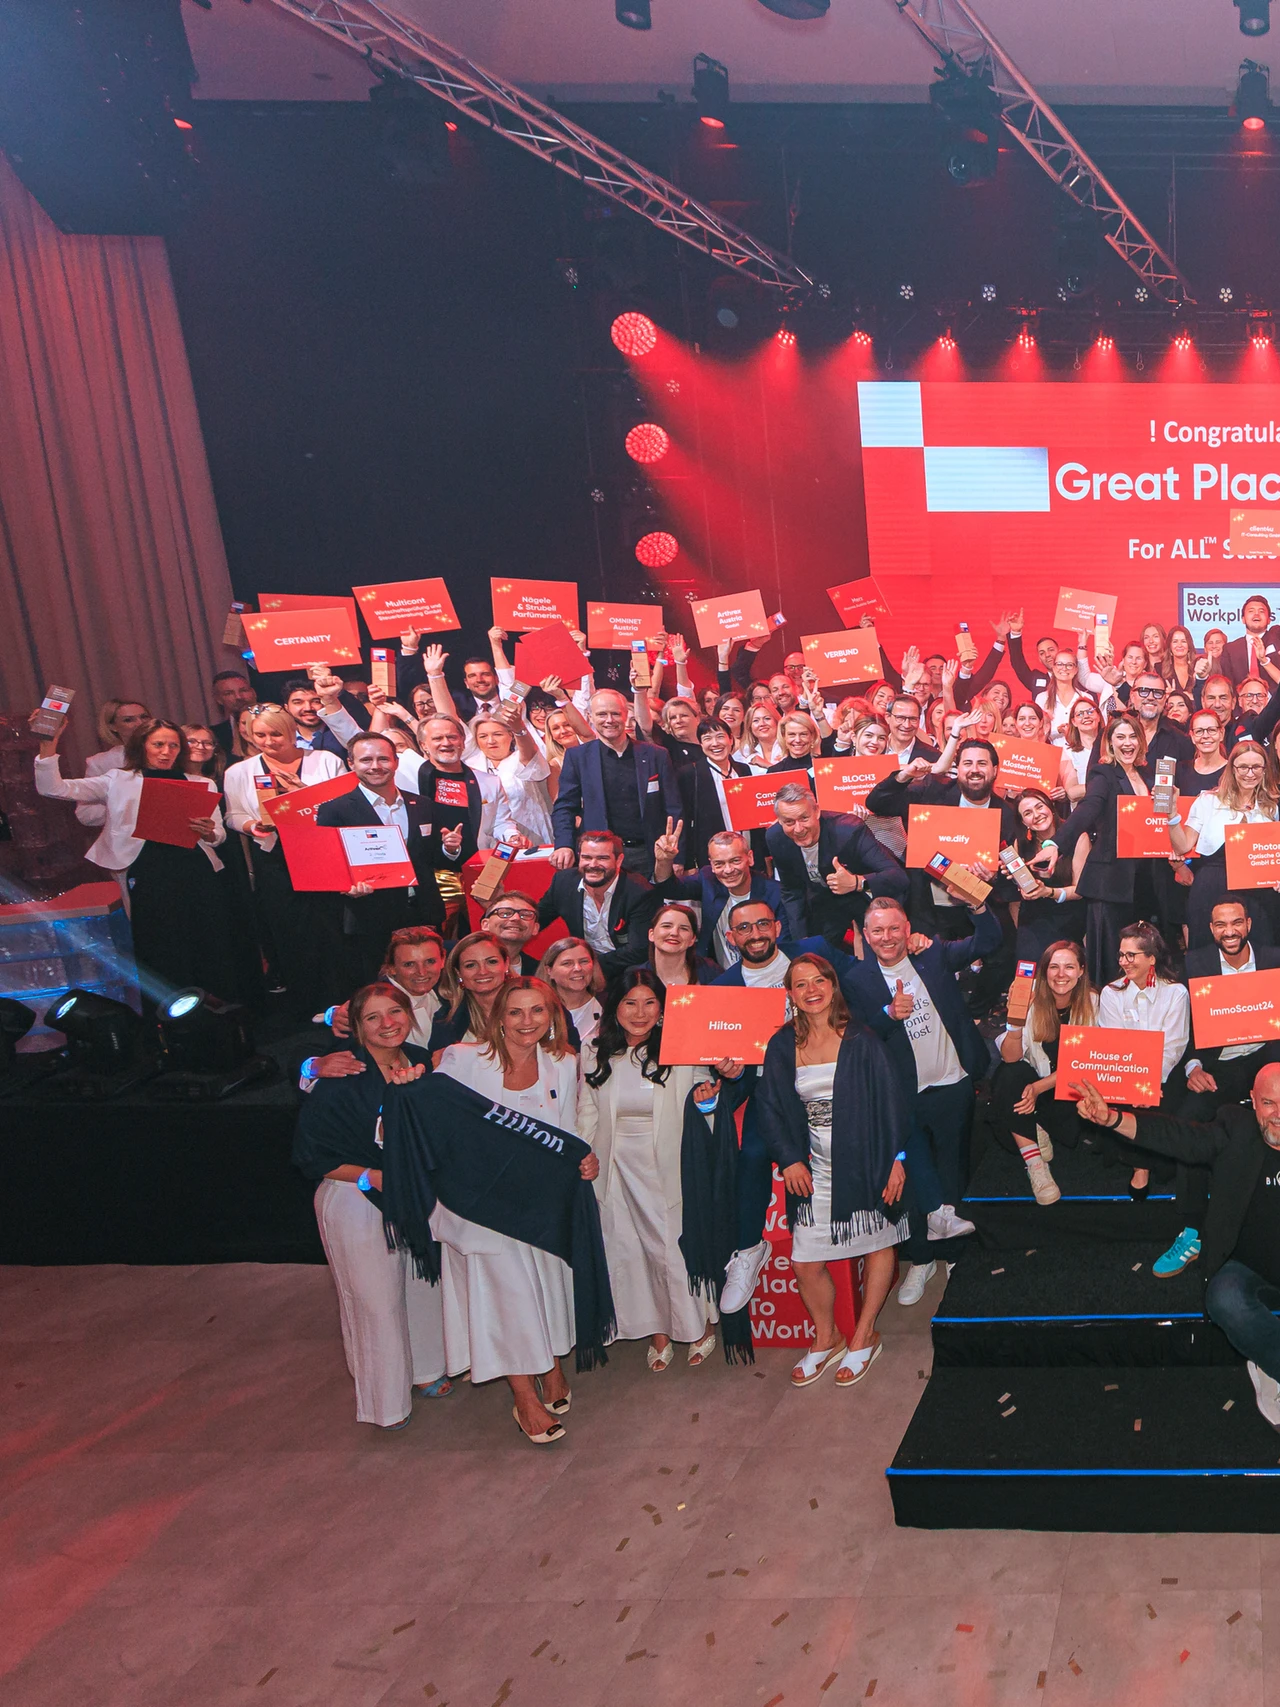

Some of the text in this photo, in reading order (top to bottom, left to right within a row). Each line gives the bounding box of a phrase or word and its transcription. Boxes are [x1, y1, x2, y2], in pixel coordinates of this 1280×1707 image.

[1055, 462, 1180, 502] Great
[1128, 538, 1165, 560] For
[385, 597, 426, 608] Multicont
[1186, 592, 1220, 606] Best
[609, 617, 642, 625] OMNINET
[274, 634, 331, 646] CERTAINITY
[824, 648, 859, 659] VERBUND
[1011, 753, 1035, 764] M.C.M.
[1003, 759, 1042, 773] Klosterfrau
[842, 773, 876, 783] BLOCH3
[297, 807, 313, 817] TD
[1145, 817, 1168, 826] ONTE
[938, 834, 970, 844] we.dify
[1209, 1000, 1274, 1016] ImmoScout24
[708, 1020, 742, 1030] Hilton
[1089, 1050, 1133, 1062] House of
[1071, 1060, 1149, 1074] Communication
[1096, 1073, 1122, 1083] Wien
[483, 1102, 565, 1154] Hilton
[750, 1298, 776, 1316] To
